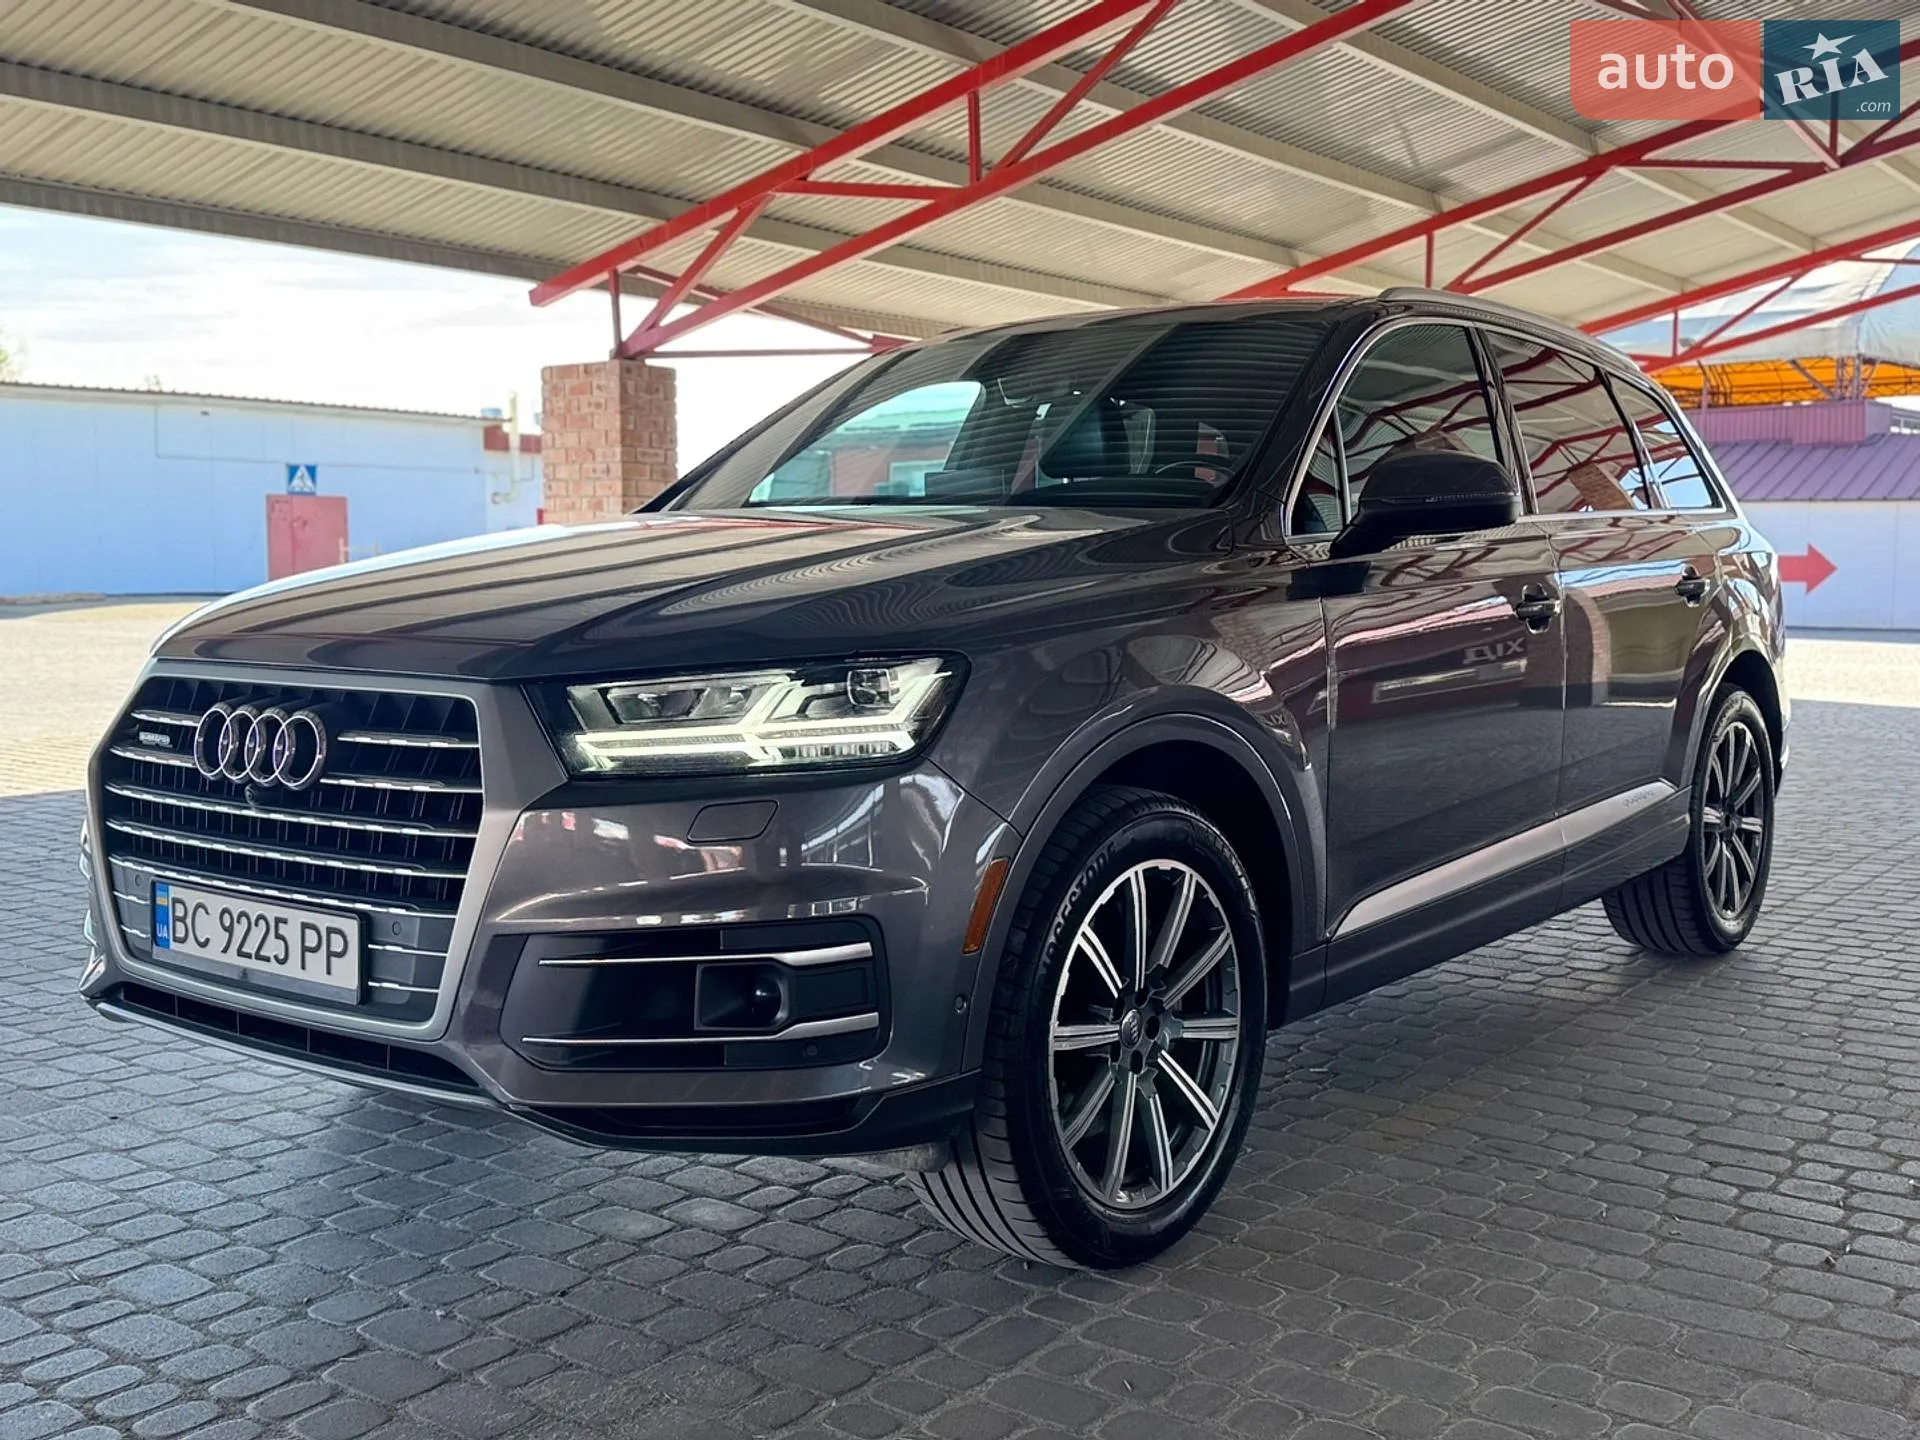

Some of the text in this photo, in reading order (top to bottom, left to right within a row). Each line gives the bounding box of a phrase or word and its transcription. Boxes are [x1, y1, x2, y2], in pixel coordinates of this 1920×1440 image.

[156, 922, 169, 940] UA
[171, 897, 349, 976] BC 9225 PP
